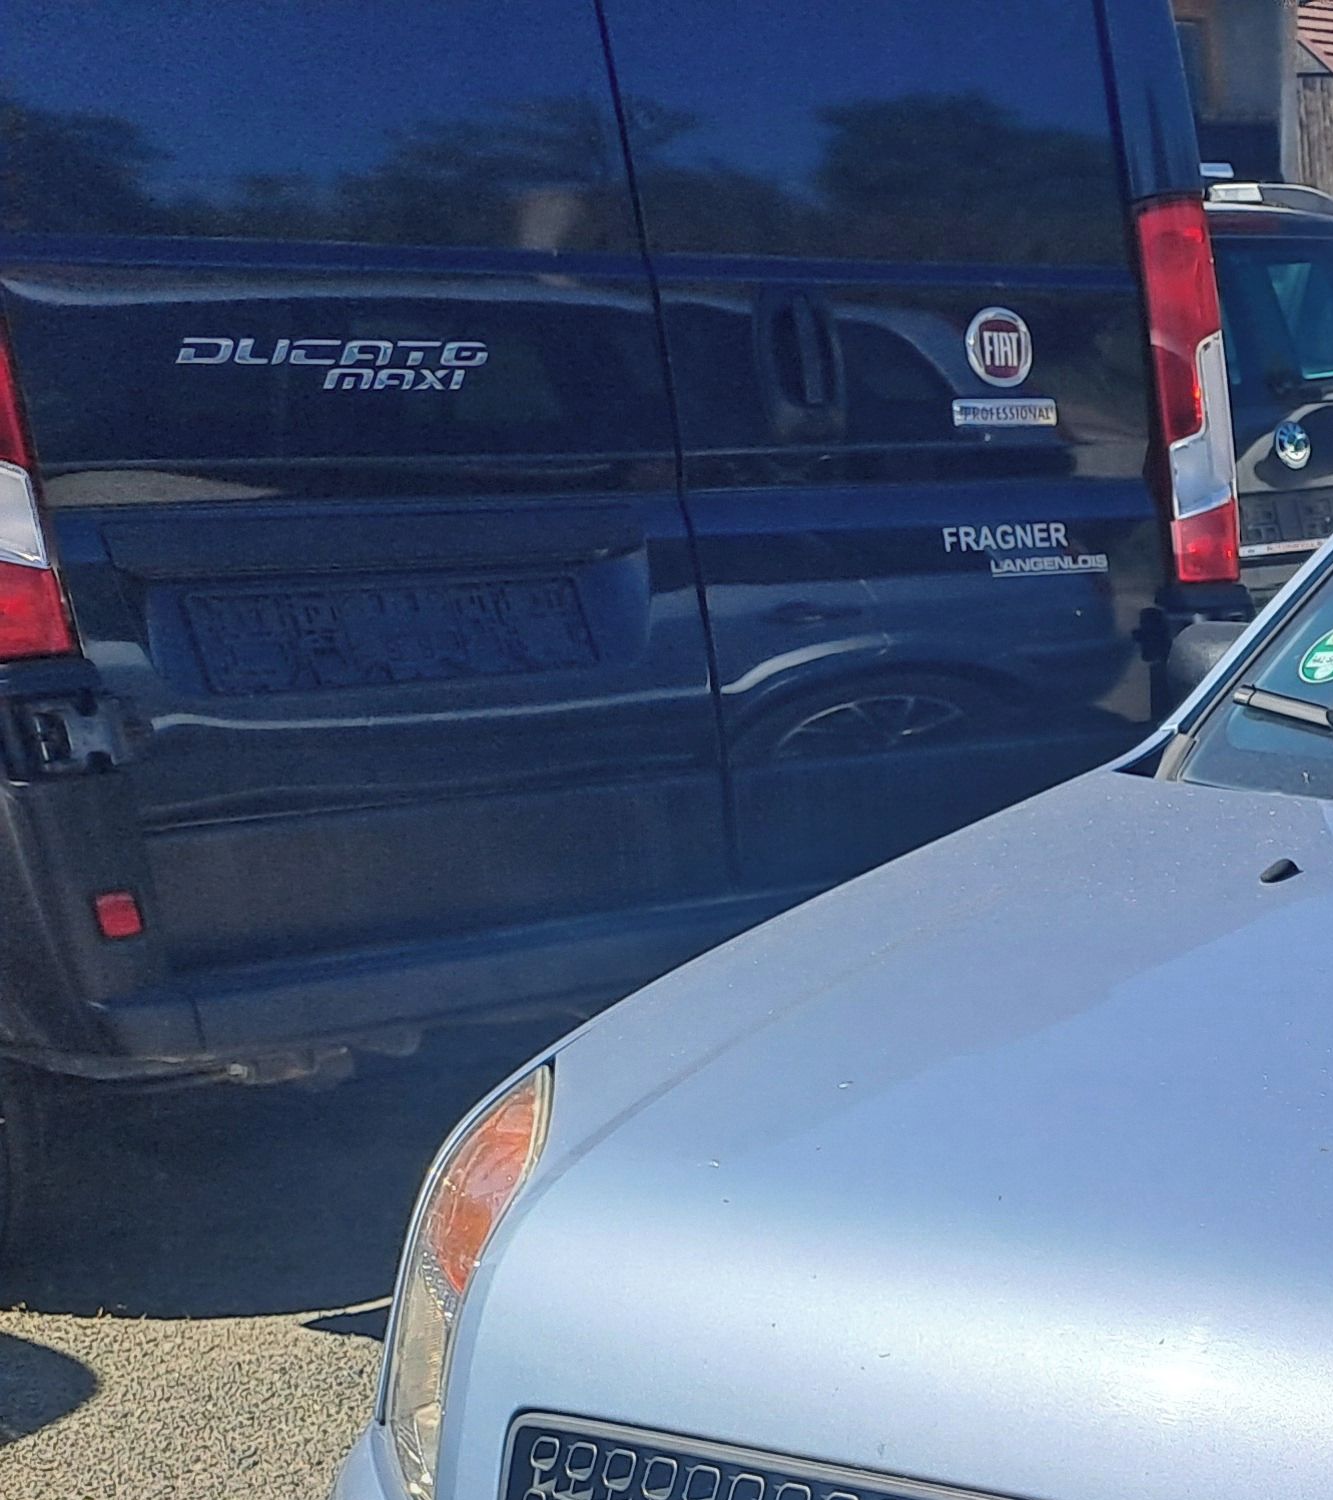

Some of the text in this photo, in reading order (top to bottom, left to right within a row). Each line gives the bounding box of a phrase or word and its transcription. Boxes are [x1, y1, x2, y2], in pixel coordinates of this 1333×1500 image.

[175, 337, 489, 366] DUCATO
[982, 330, 1019, 367] FIAT
[322, 368, 465, 390] MAXI
[961, 405, 1052, 422] PROFESSIONAL
[942, 522, 1069, 552] FRAGNER
[990, 554, 1108, 573] LANGENLOIS
